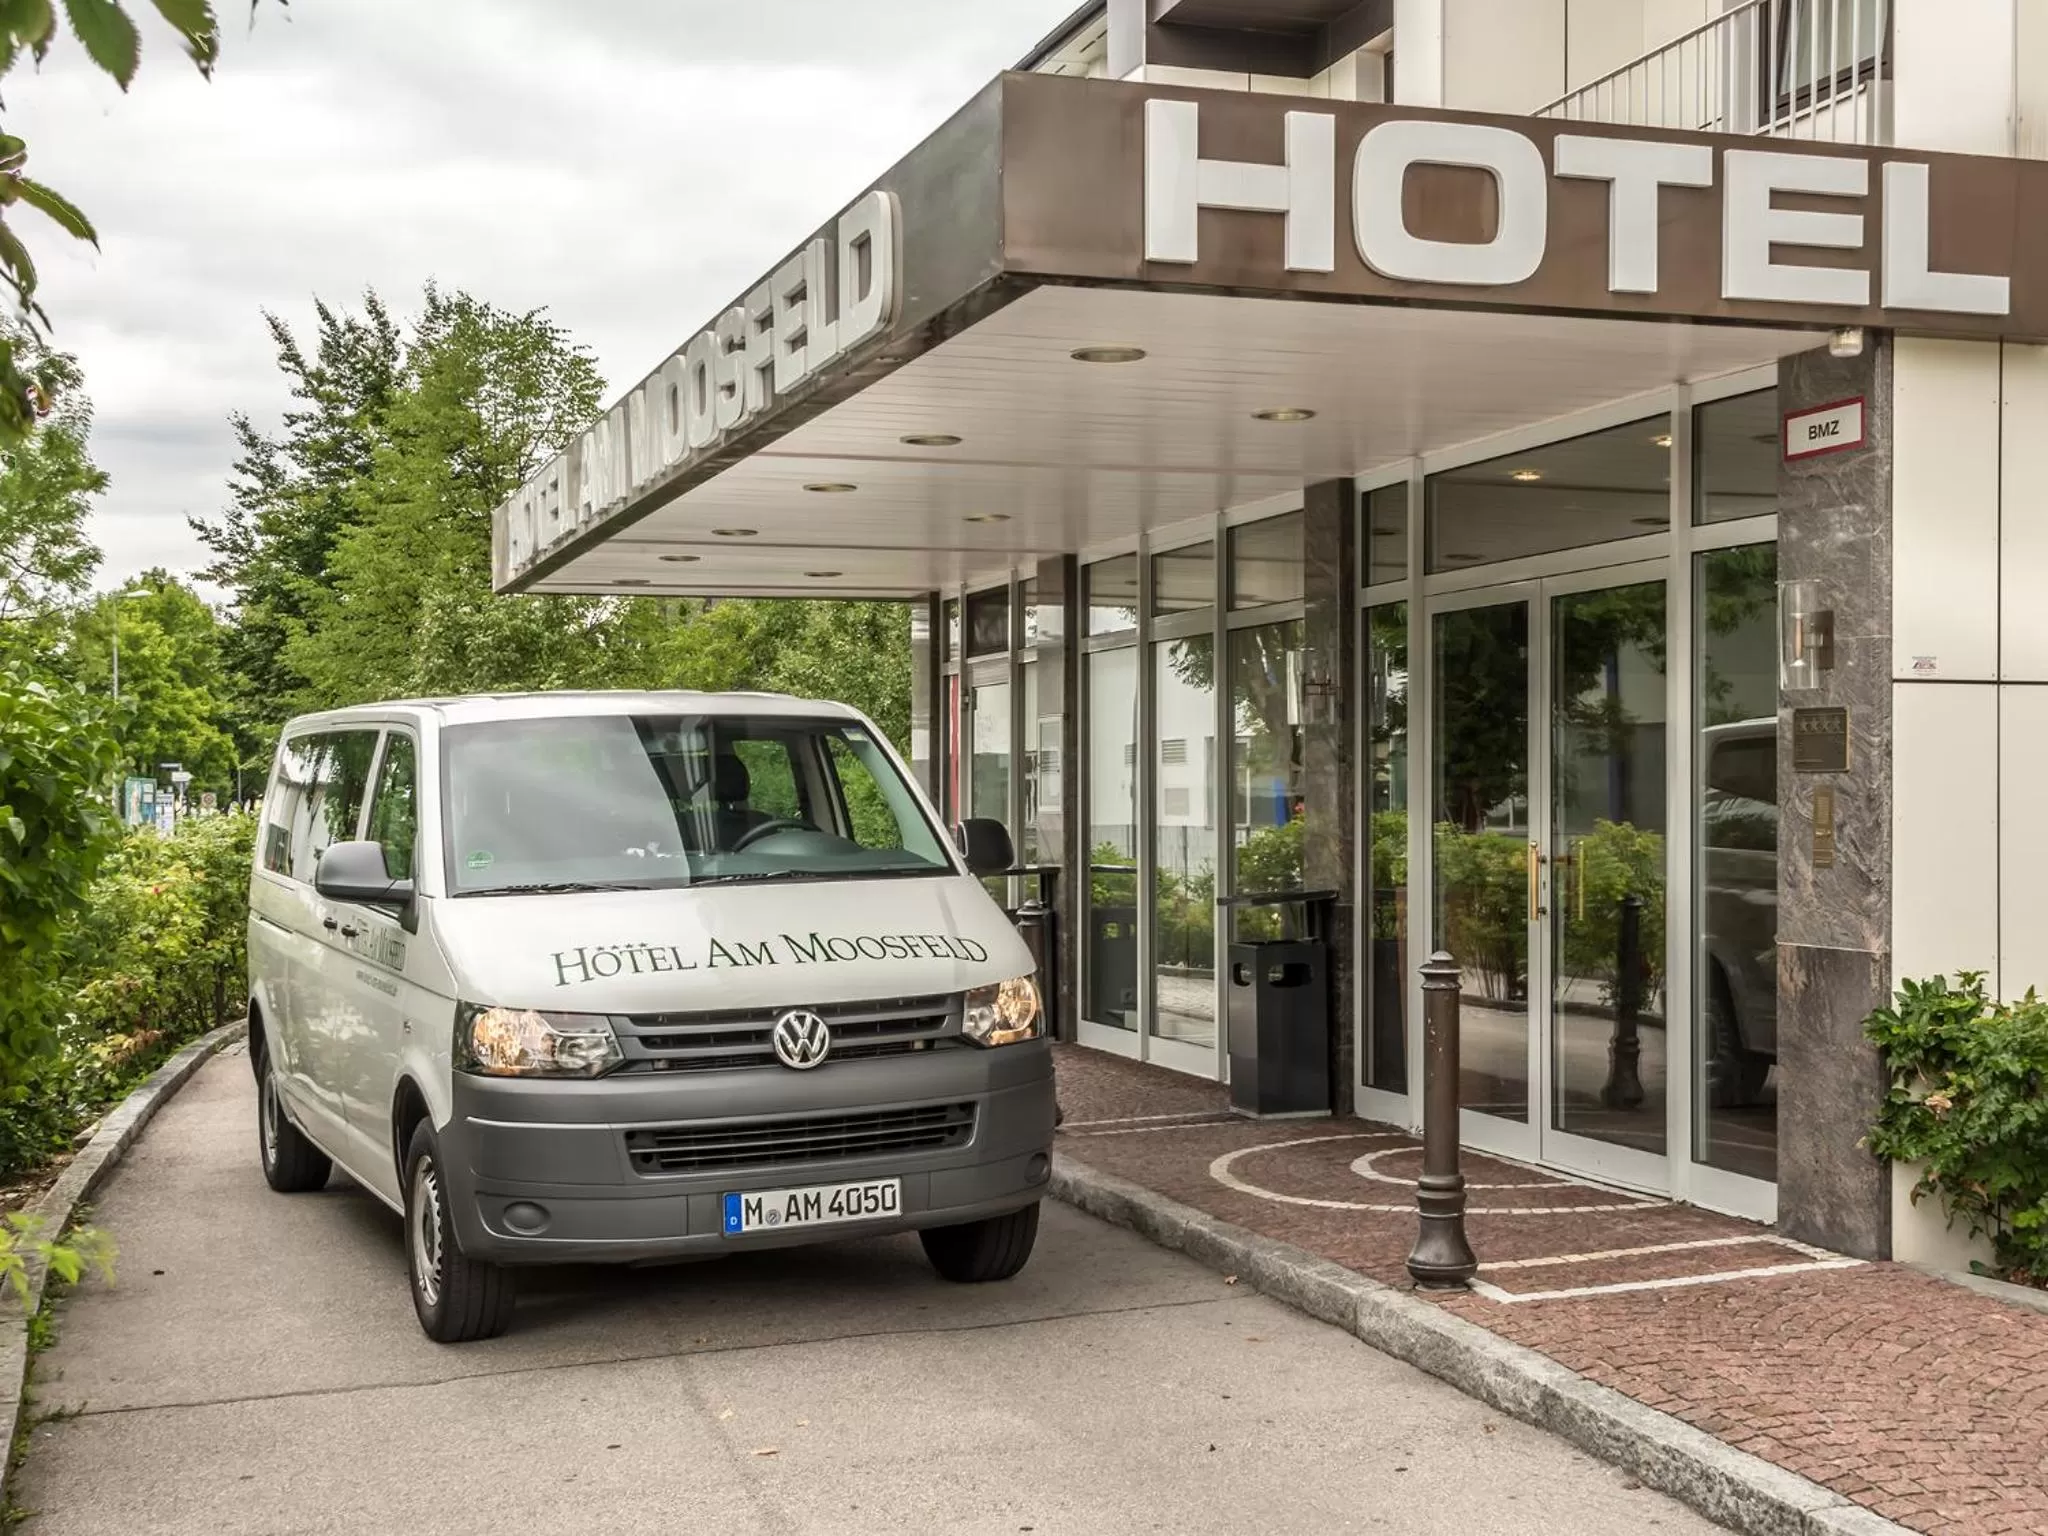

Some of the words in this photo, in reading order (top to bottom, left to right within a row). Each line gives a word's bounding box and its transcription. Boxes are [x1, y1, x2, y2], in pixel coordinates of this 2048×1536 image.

[1144, 98, 2011, 315] HOTEL
[1808, 420, 1840, 440] BMZ
[550, 946, 698, 987] HOTEL
[707, 936, 782, 968] AM
[778, 932, 988, 962] MOOSFELD
[744, 1197, 764, 1226] M
[784, 1191, 822, 1223] AM
[828, 1183, 897, 1217] 4050
